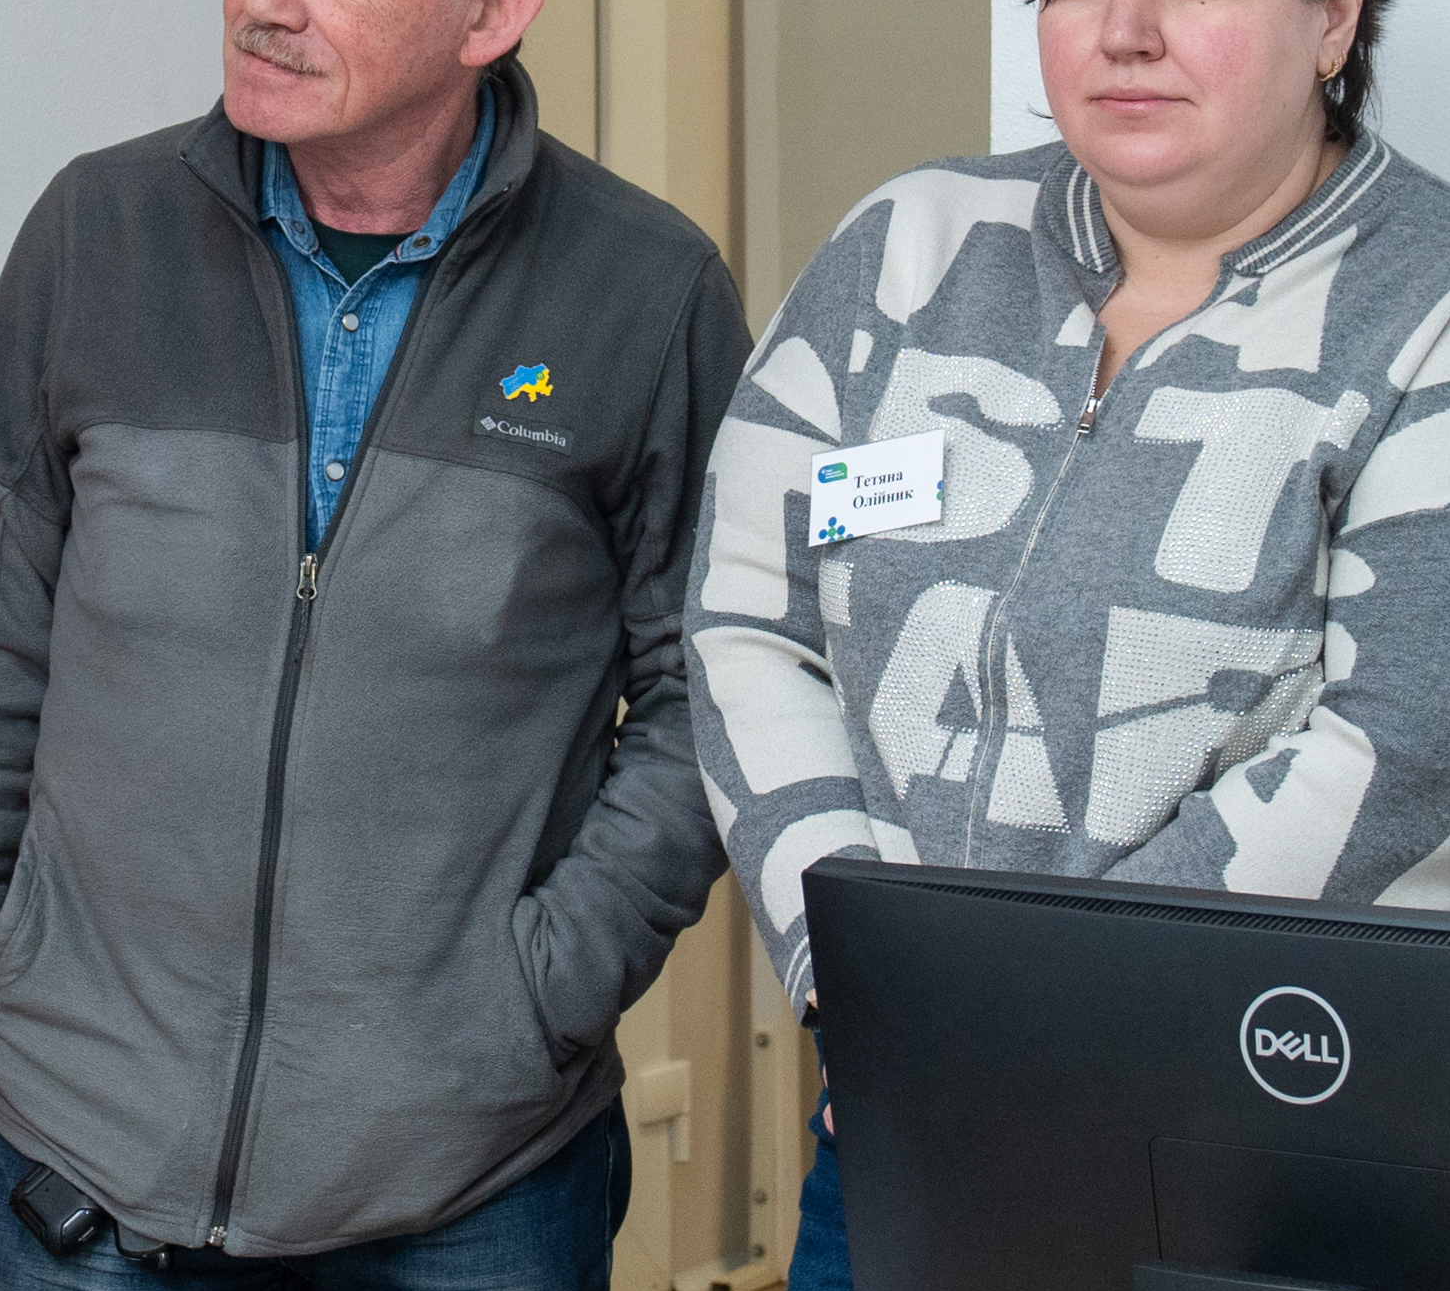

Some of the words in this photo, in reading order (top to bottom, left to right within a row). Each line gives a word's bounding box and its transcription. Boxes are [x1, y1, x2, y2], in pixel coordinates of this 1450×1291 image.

[497, 420, 566, 447] Columbia
[853, 471, 903, 489] Тетяна
[852, 489, 914, 509] Олійник
[1254, 1027, 1339, 1064] DELL
